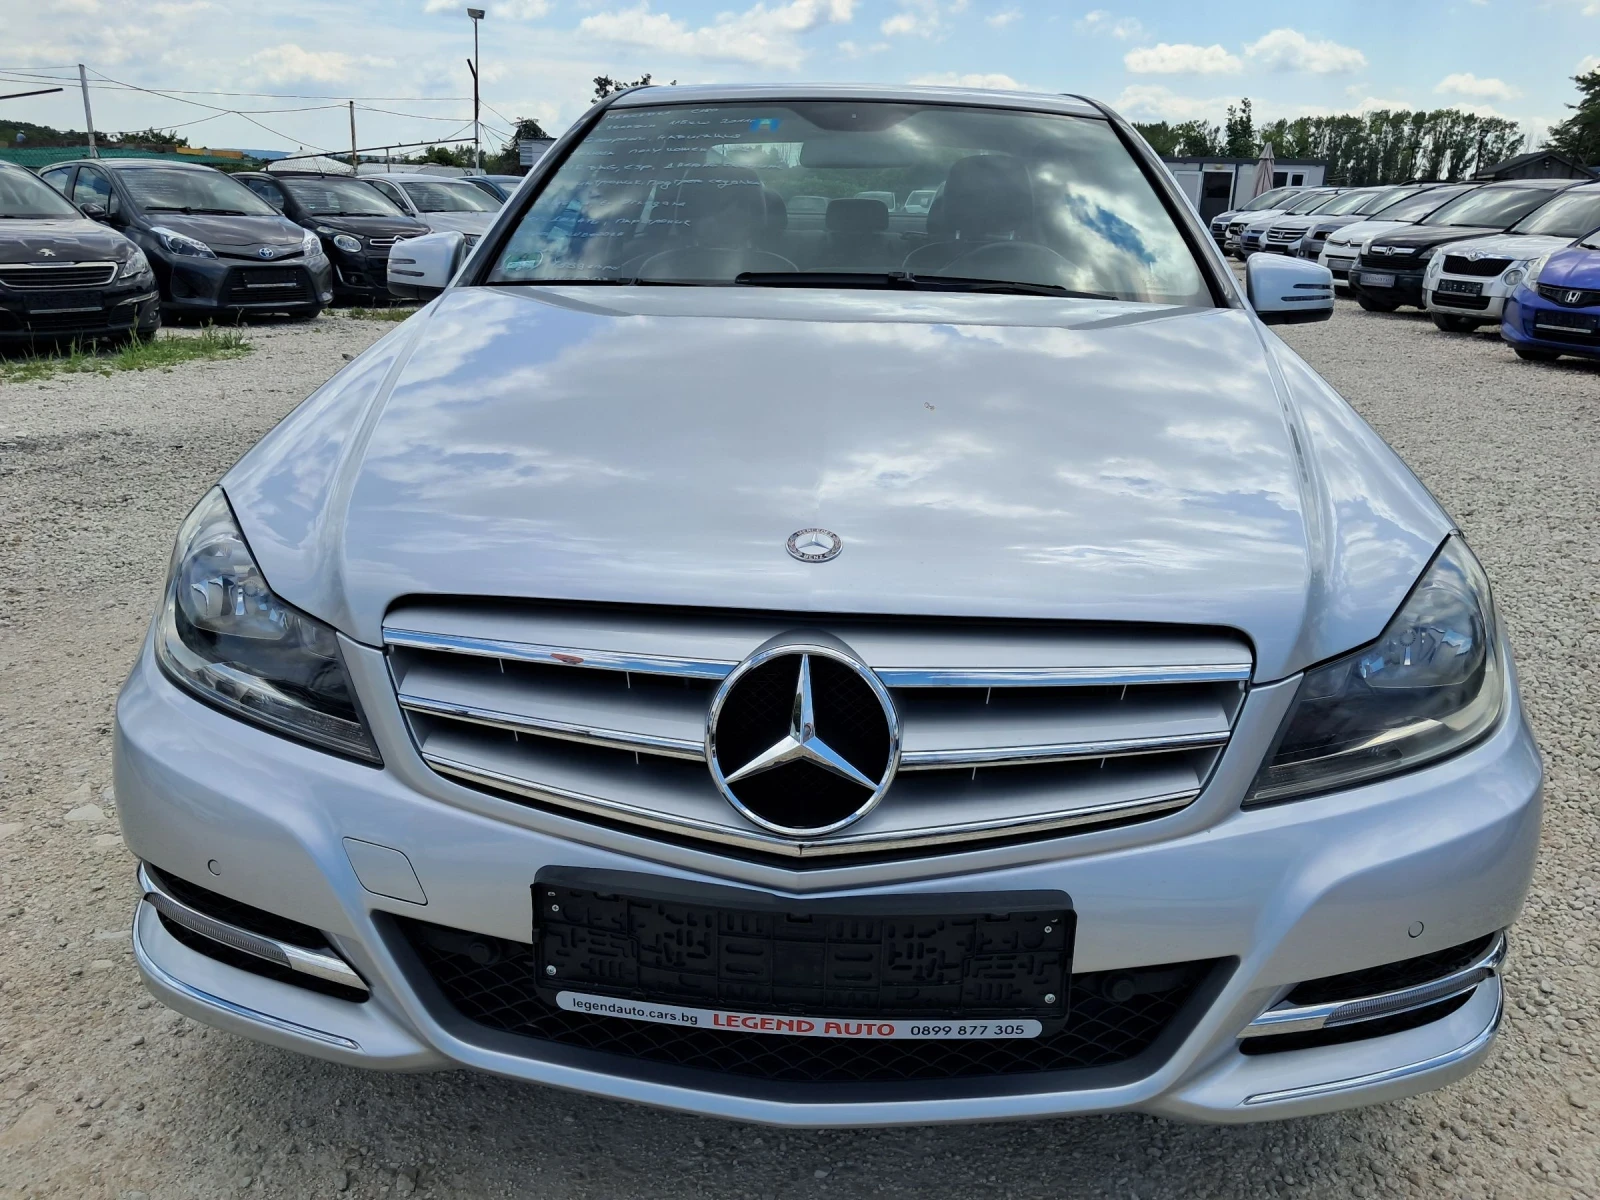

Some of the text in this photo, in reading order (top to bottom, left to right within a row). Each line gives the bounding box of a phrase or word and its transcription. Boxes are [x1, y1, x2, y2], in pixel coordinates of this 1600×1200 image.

[572, 997, 1025, 1036] legendauto.cars.bg LEGEND AUTO 0899 877 305
